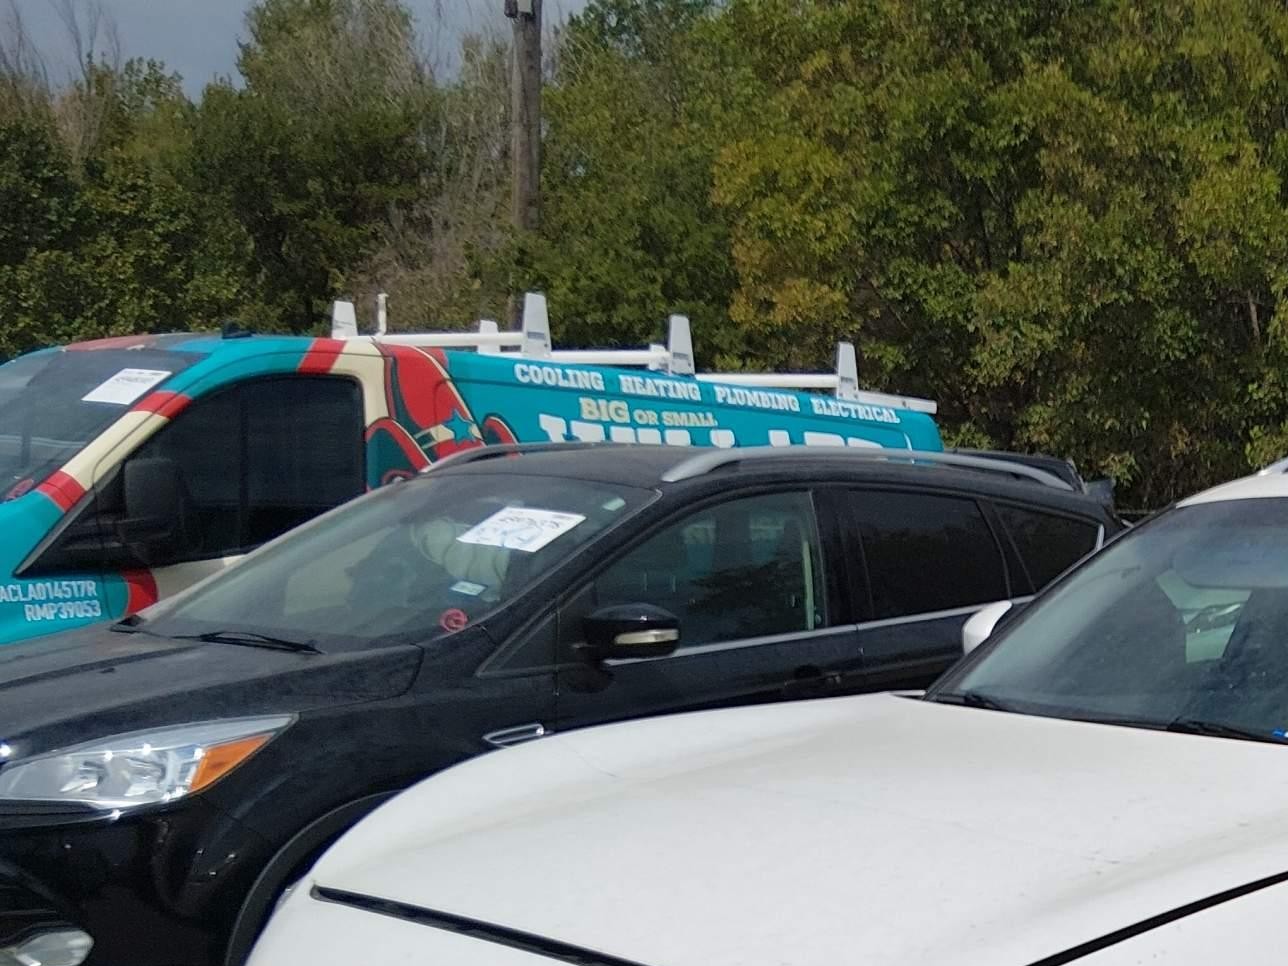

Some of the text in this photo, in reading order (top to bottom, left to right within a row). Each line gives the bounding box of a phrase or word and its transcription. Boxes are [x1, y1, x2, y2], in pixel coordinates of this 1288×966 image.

[514, 363, 900, 424] COOLING HEATING PLUMBING ELECTRICAL
[579, 397, 717, 427] BIG OR SMALL
